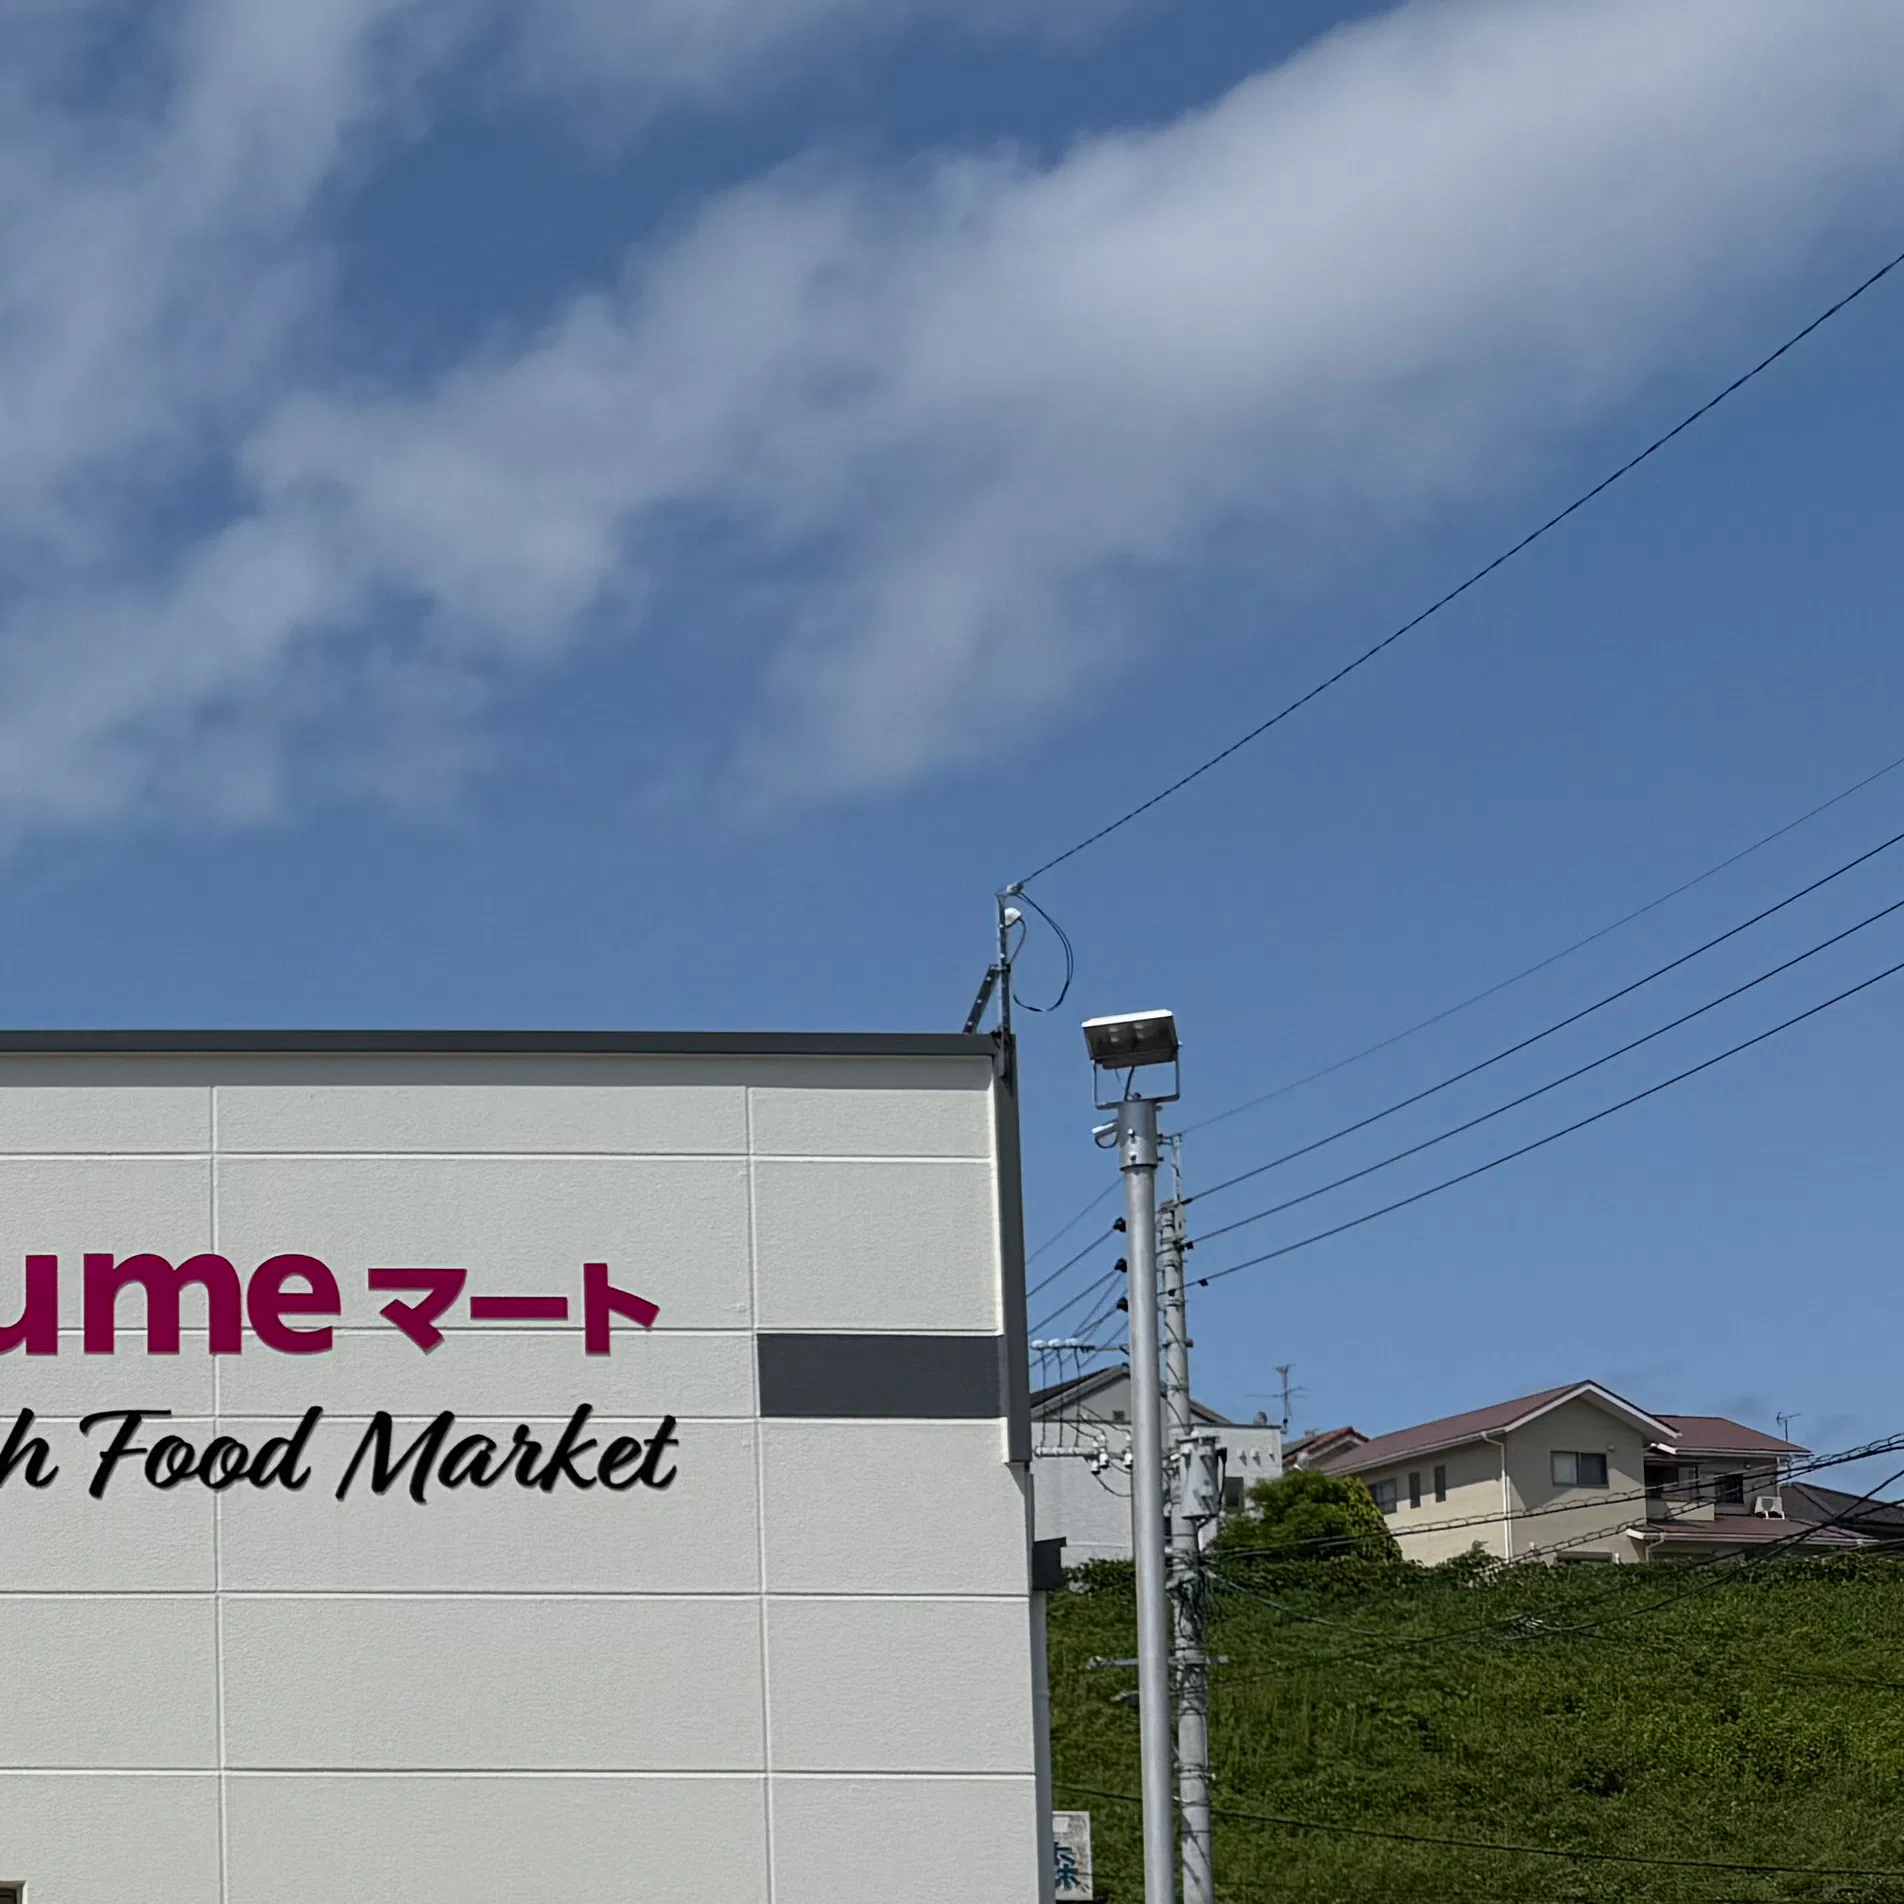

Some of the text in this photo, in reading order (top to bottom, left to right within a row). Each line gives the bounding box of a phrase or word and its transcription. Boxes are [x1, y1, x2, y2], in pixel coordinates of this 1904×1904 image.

[367, 1261, 661, 1357] マート
[78, 1405, 324, 1499] Food
[335, 1402, 679, 1504] Market
